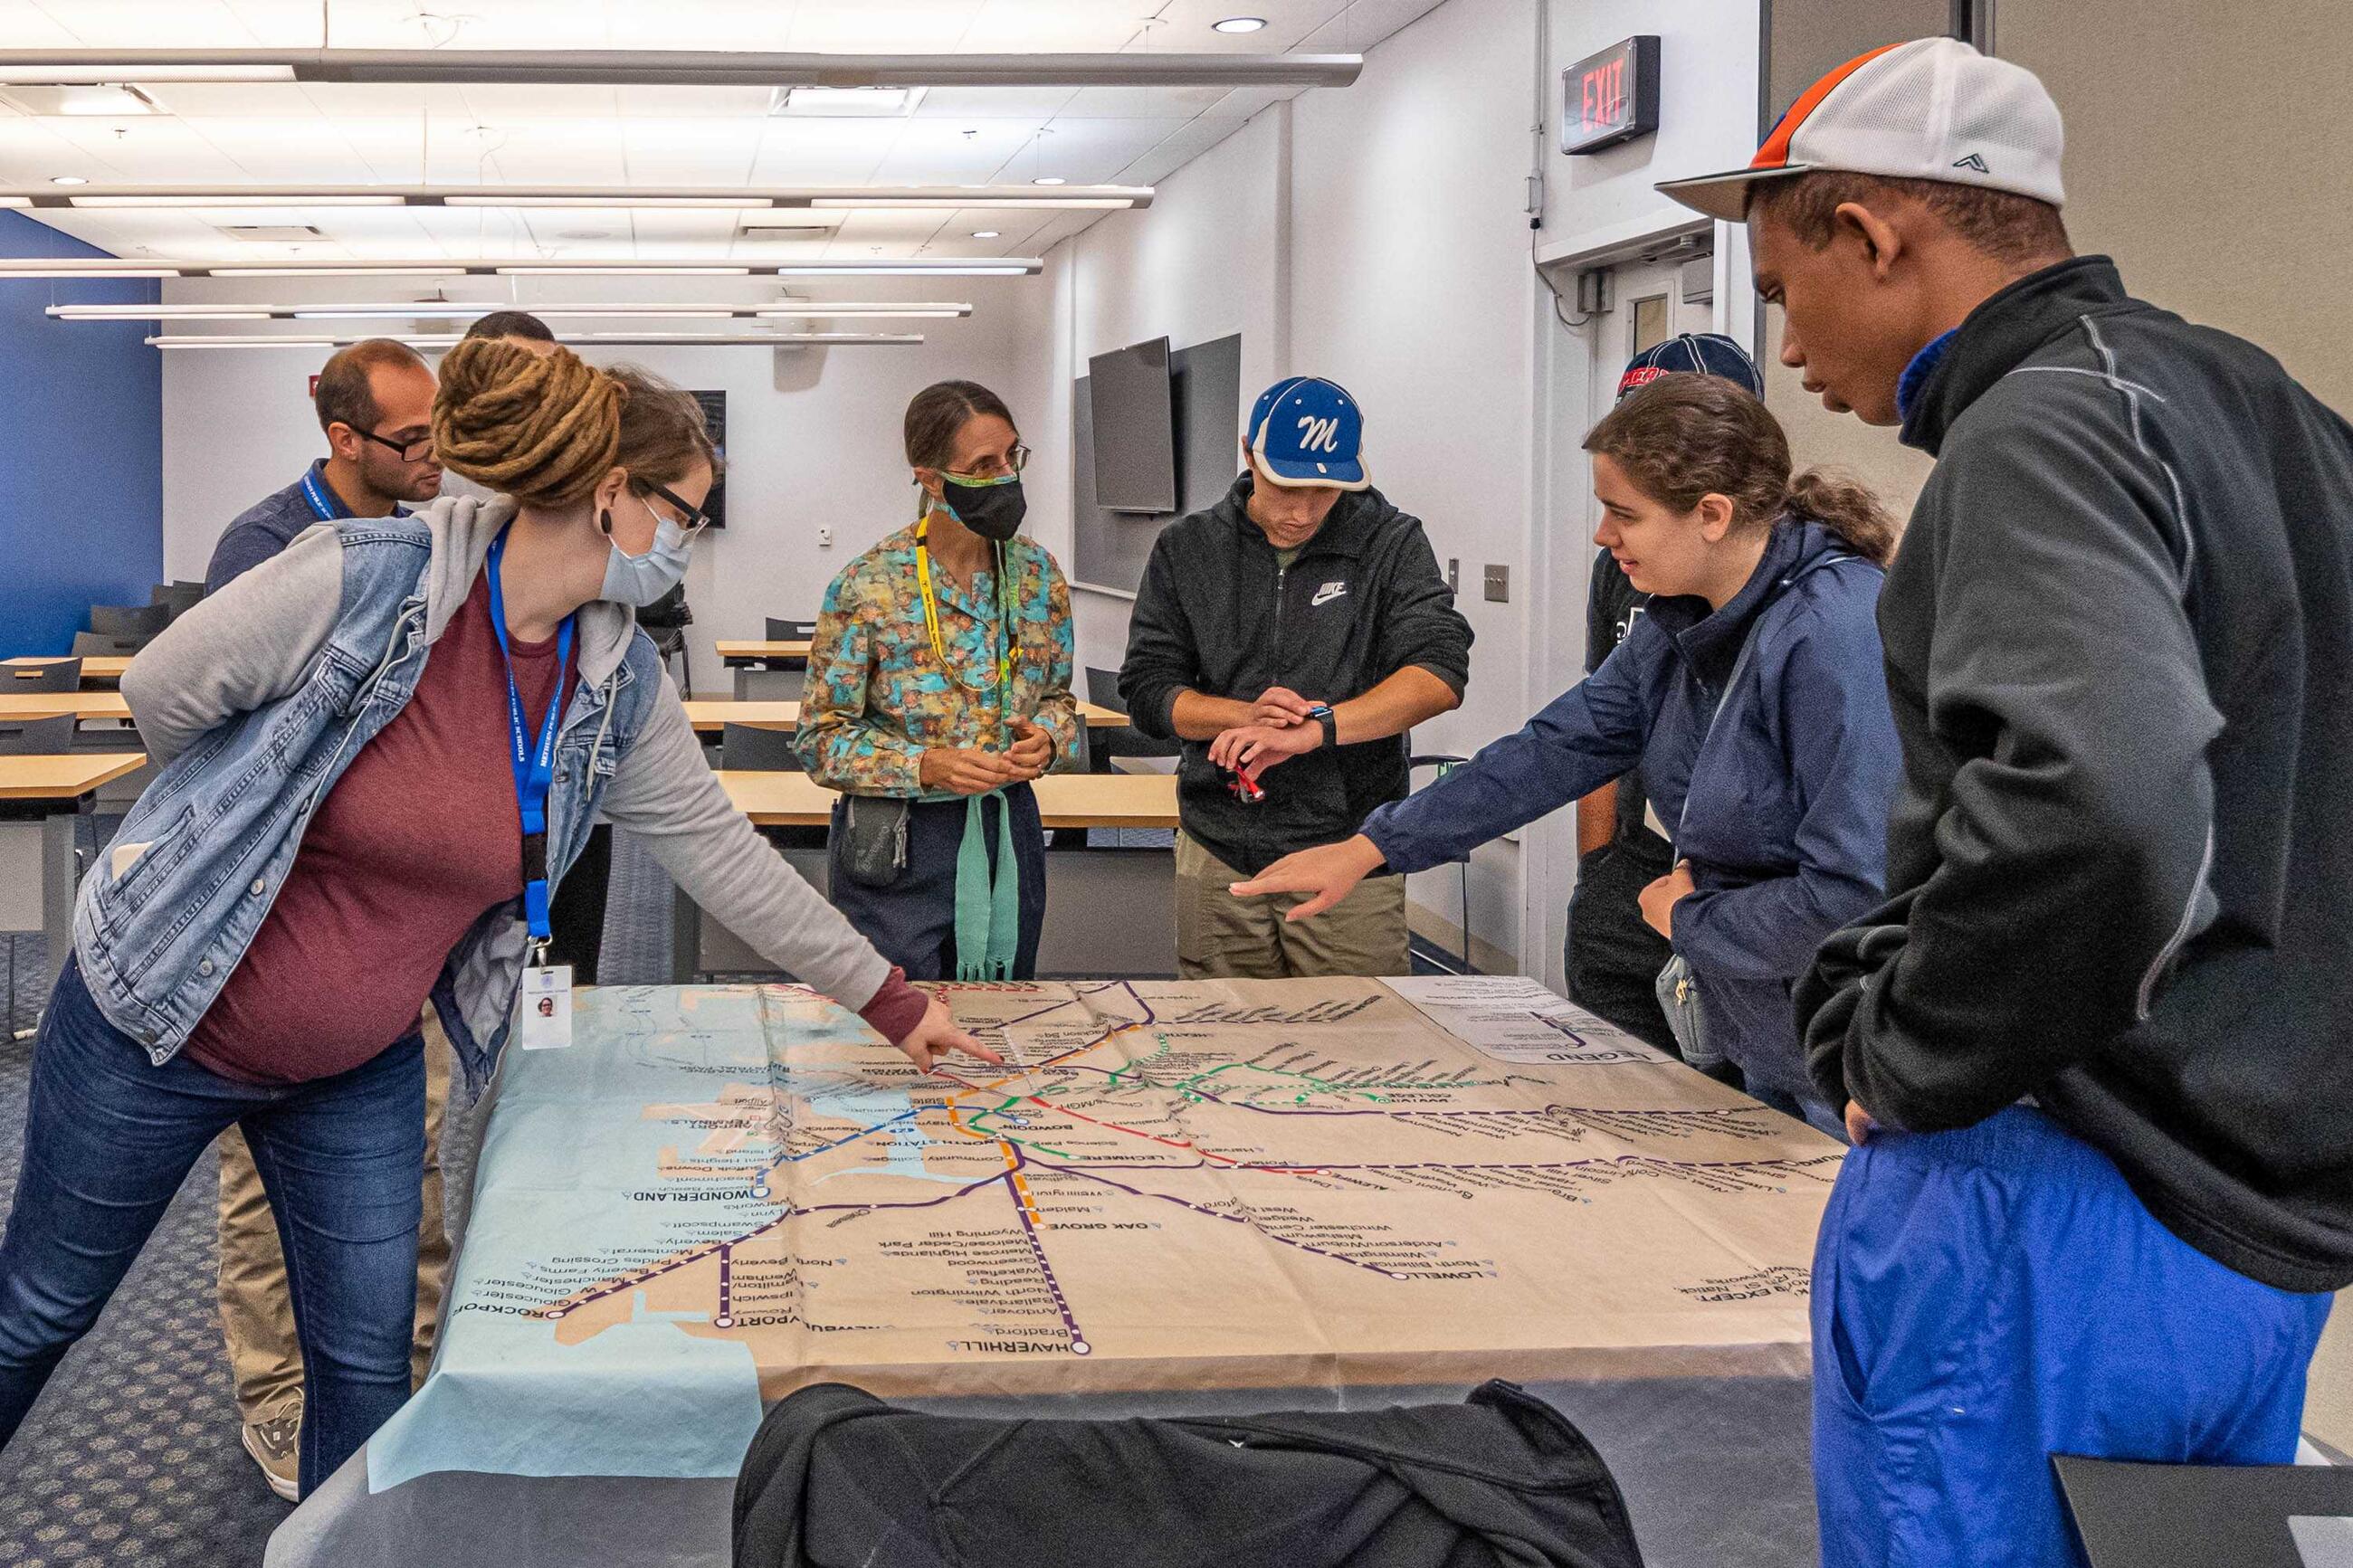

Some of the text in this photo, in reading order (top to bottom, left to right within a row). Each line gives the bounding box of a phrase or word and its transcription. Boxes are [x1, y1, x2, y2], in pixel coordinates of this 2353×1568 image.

[1581, 57, 1624, 133] EXIT
[1298, 415, 1338, 452] M
[515, 726, 526, 762] SCHOOLS
[1546, 1050, 1651, 1061] LEGEND
[876, 1139, 938, 1147] STATION
[1296, 1175, 1332, 1188] Davis
[634, 1190, 749, 1202] WONDERLAND
[1050, 1222, 1148, 1231] OAK GROVE
[955, 1229, 1024, 1240] Wyoming
[878, 1239, 1029, 1249] Melrose/Cedar Park
[972, 1248, 1033, 1256] Melrose
[1339, 1250, 1427, 1259] Wilmington
[551, 1257, 672, 1266] Prides Crossing
[948, 1258, 1037, 1267] Greenwood
[540, 1266, 650, 1275] Beverly Farms
[966, 1268, 1042, 1277] Wakefield
[1406, 1271, 1484, 1279] LOWELL
[534, 1276, 626, 1285] Manchester
[980, 1278, 1046, 1286] Reading
[484, 1279, 572, 1296] Gloucester
[1005, 1287, 1050, 1296] North
[482, 1290, 572, 1307] Gloucester
[966, 1297, 1054, 1306] Ballardvale
[995, 1328, 1069, 1337] Bradford
[959, 1341, 1069, 1353] HAVERHILL
